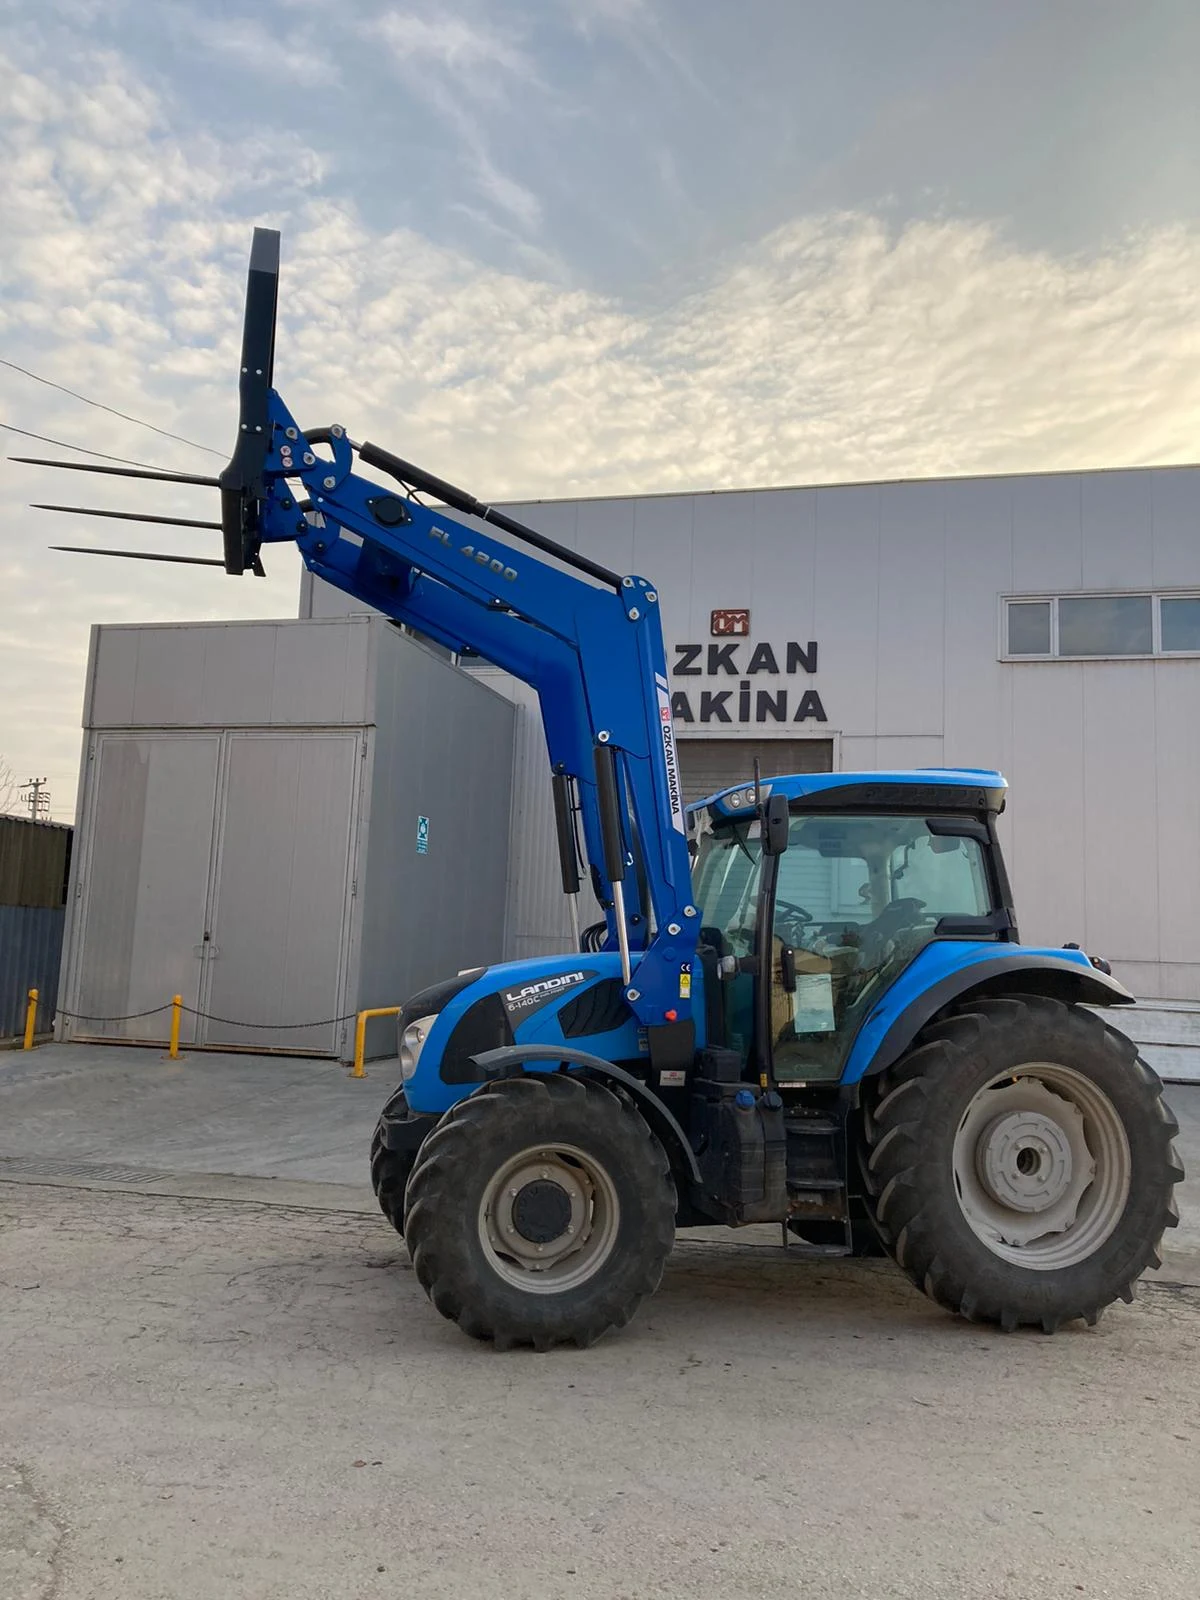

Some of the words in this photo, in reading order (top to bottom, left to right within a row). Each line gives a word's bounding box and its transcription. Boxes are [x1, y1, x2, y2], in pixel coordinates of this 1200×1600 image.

[672, 641, 818, 676] ZKAN
[670, 680, 829, 723] AKİNA
[506, 972, 584, 1002] LANDINI
